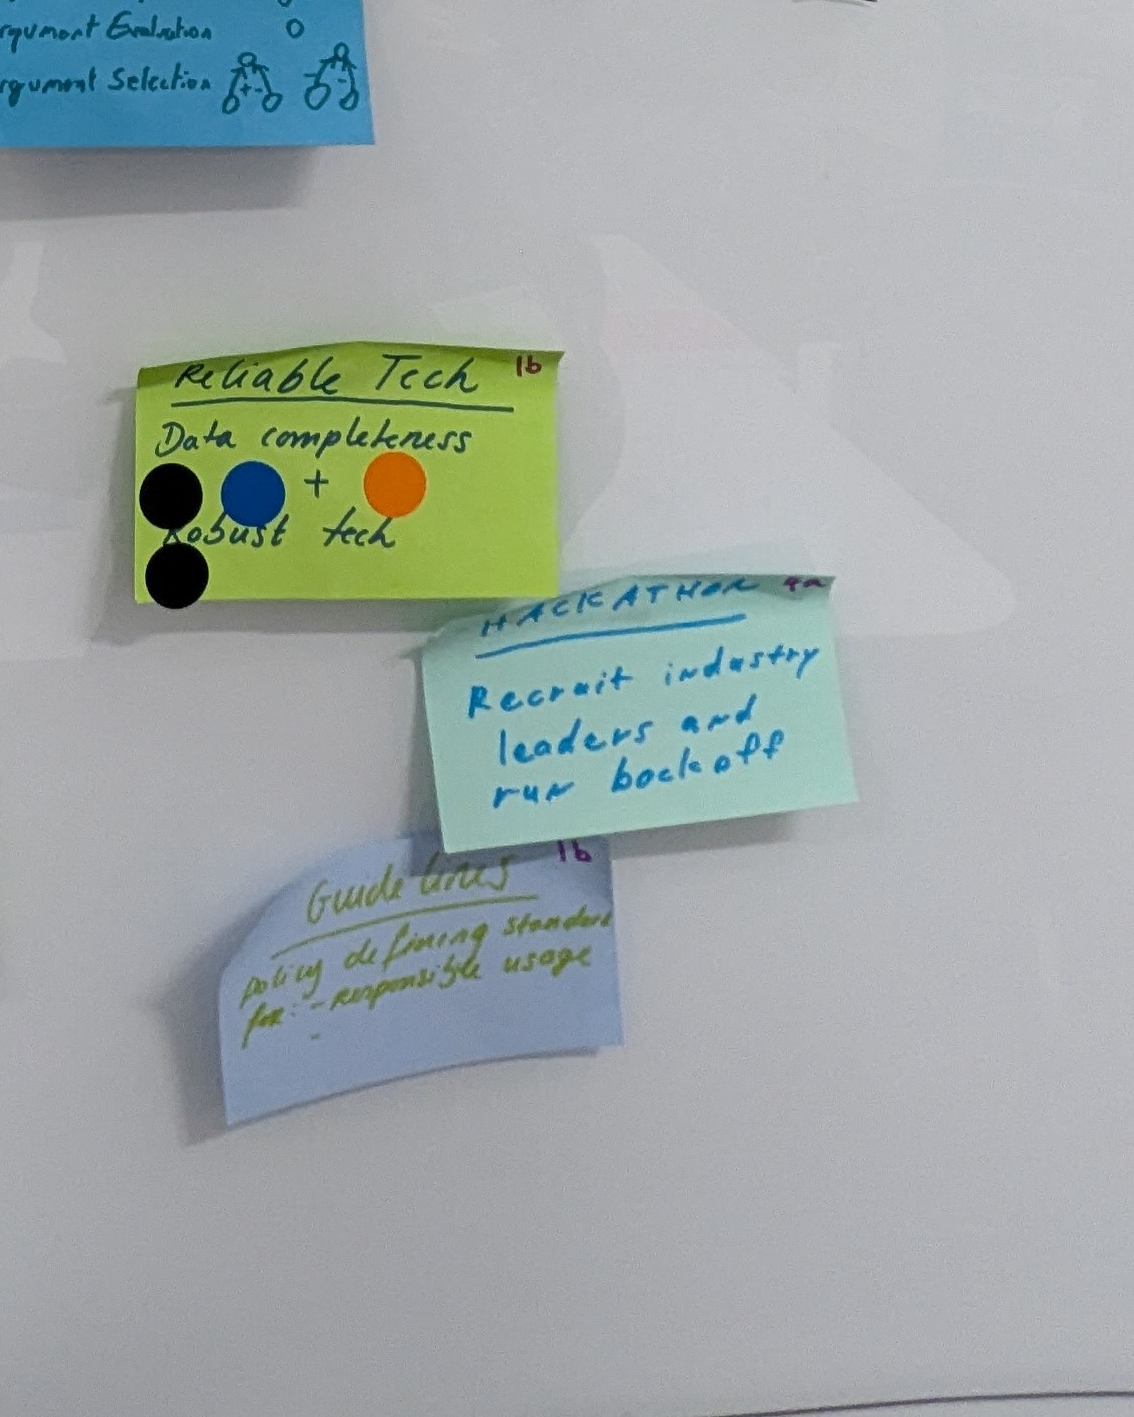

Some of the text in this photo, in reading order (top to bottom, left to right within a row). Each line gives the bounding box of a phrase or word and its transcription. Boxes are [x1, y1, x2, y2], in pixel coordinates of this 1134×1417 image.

[108, 62, 212, 91] Selection
[175, 354, 479, 397] Reliable Tech
[155, 419, 236, 457] Data
[323, 507, 397, 547] tech
[467, 644, 820, 718] Recruit industry
[499, 693, 757, 766] leaders and
[493, 781, 575, 808] run
[503, 945, 592, 978] usage
